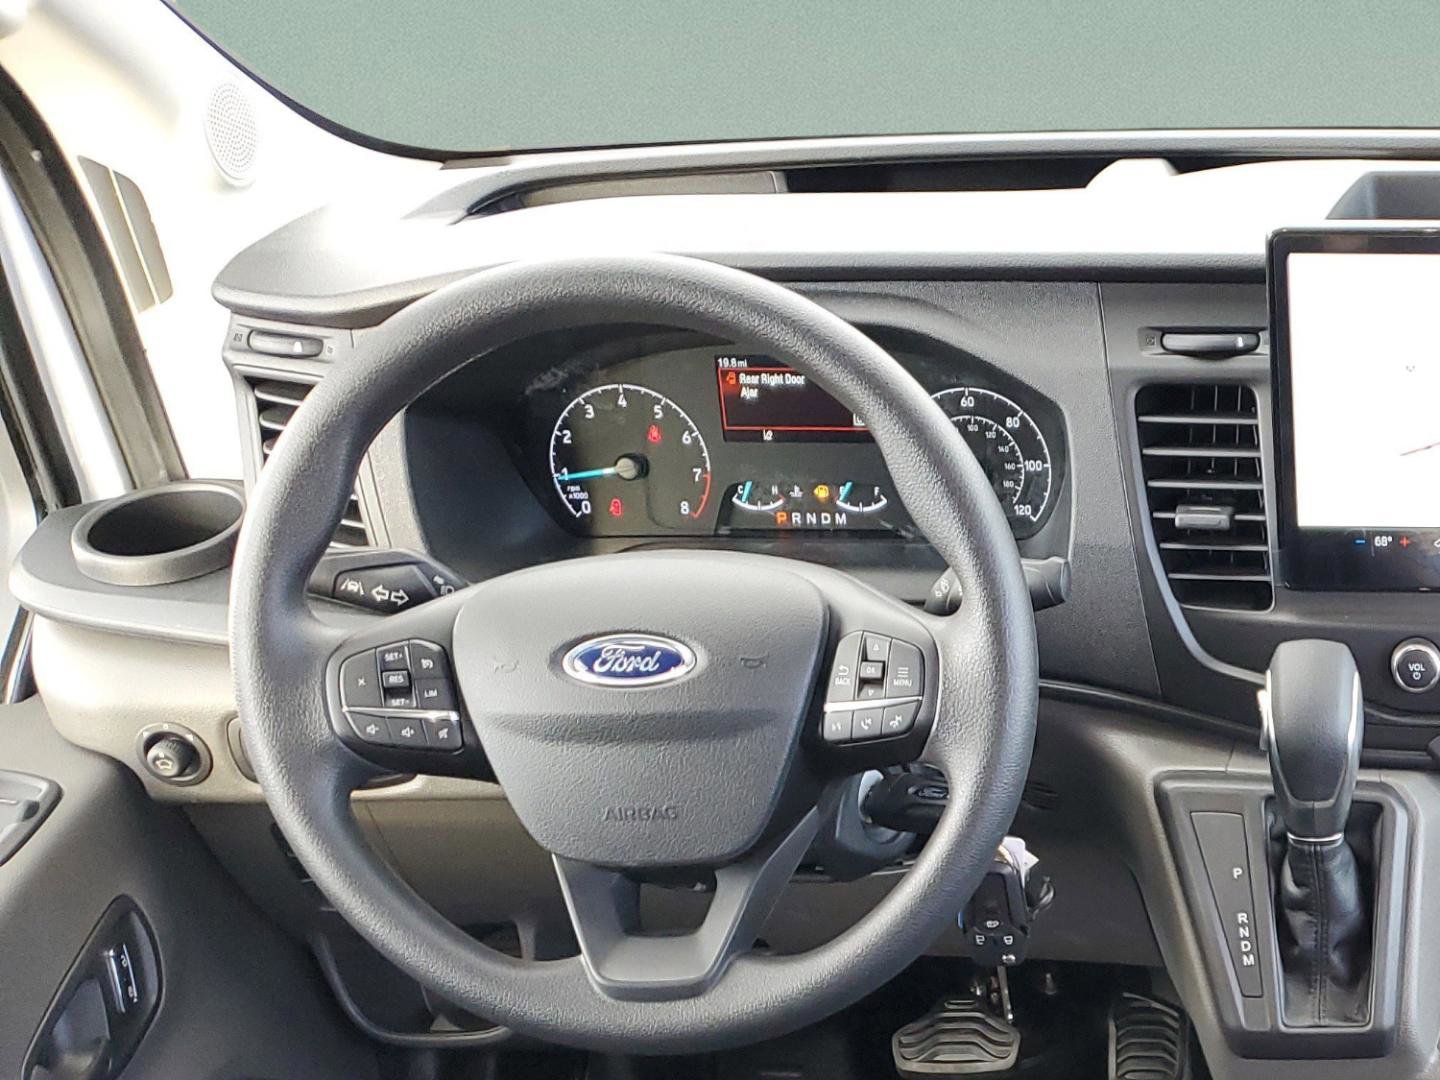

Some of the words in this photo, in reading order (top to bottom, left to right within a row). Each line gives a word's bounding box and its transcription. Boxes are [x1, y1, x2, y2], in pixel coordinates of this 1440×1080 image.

[739, 373, 760, 384] Rear
[761, 373, 784, 386] Right
[785, 373, 805, 384] Door
[741, 387, 759, 399] Ajar
[617, 394, 627, 408] 4
[960, 397, 974, 407] 60
[584, 404, 595, 419] 3
[653, 405, 664, 419] 5
[1006, 417, 1020, 427] 80
[562, 430, 572, 444] 2
[682, 430, 692, 444] 6
[1024, 460, 1042, 471] 100
[693, 468, 702, 482] 7
[581, 500, 591, 514] 0
[680, 501, 690, 515] 8
[1014, 504, 1031, 515] 120
[776, 512, 787, 525] P
[792, 512, 802, 524] R
[806, 513, 817, 524] N
[821, 513, 831, 524] D
[835, 513, 847, 525] M
[593, 644, 660, 673] Ford
[1408, 662, 1426, 671] VOL
[893, 679, 912, 687] MENU
[424, 689, 437, 698] LIM
[602, 805, 679, 821] AIRBAG
[1233, 868, 1243, 879] P
[1237, 913, 1248, 924] R
[1239, 927, 1249, 938] N
[1241, 941, 1251, 952] D
[1243, 955, 1255, 966] M
